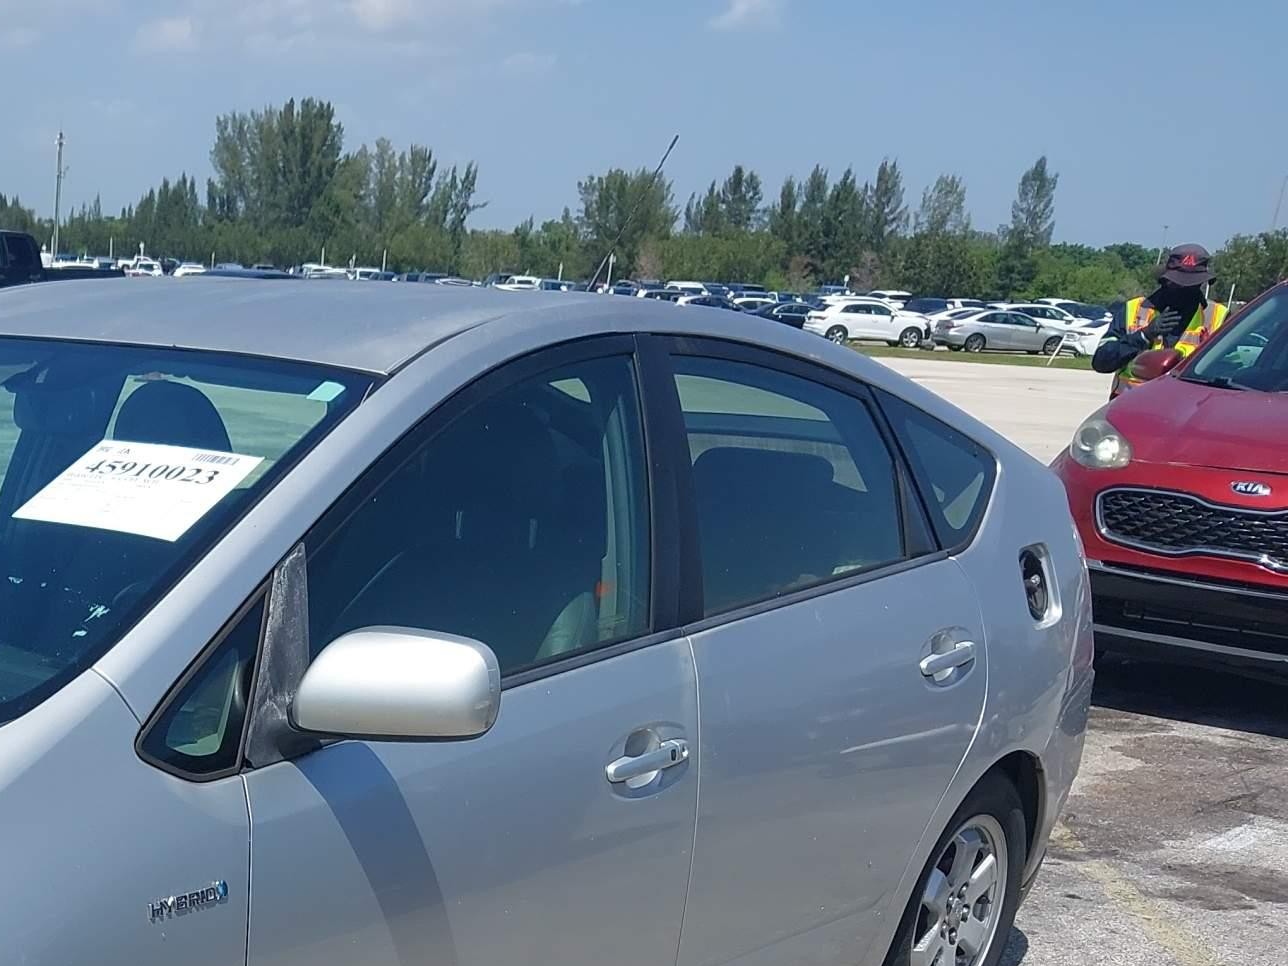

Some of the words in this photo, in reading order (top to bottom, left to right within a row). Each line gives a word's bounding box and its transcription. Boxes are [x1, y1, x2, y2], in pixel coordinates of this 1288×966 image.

[85, 459, 221, 485] 45910023
[1235, 481, 1267, 495] KIA
[149, 886, 218, 918] HYBRID
